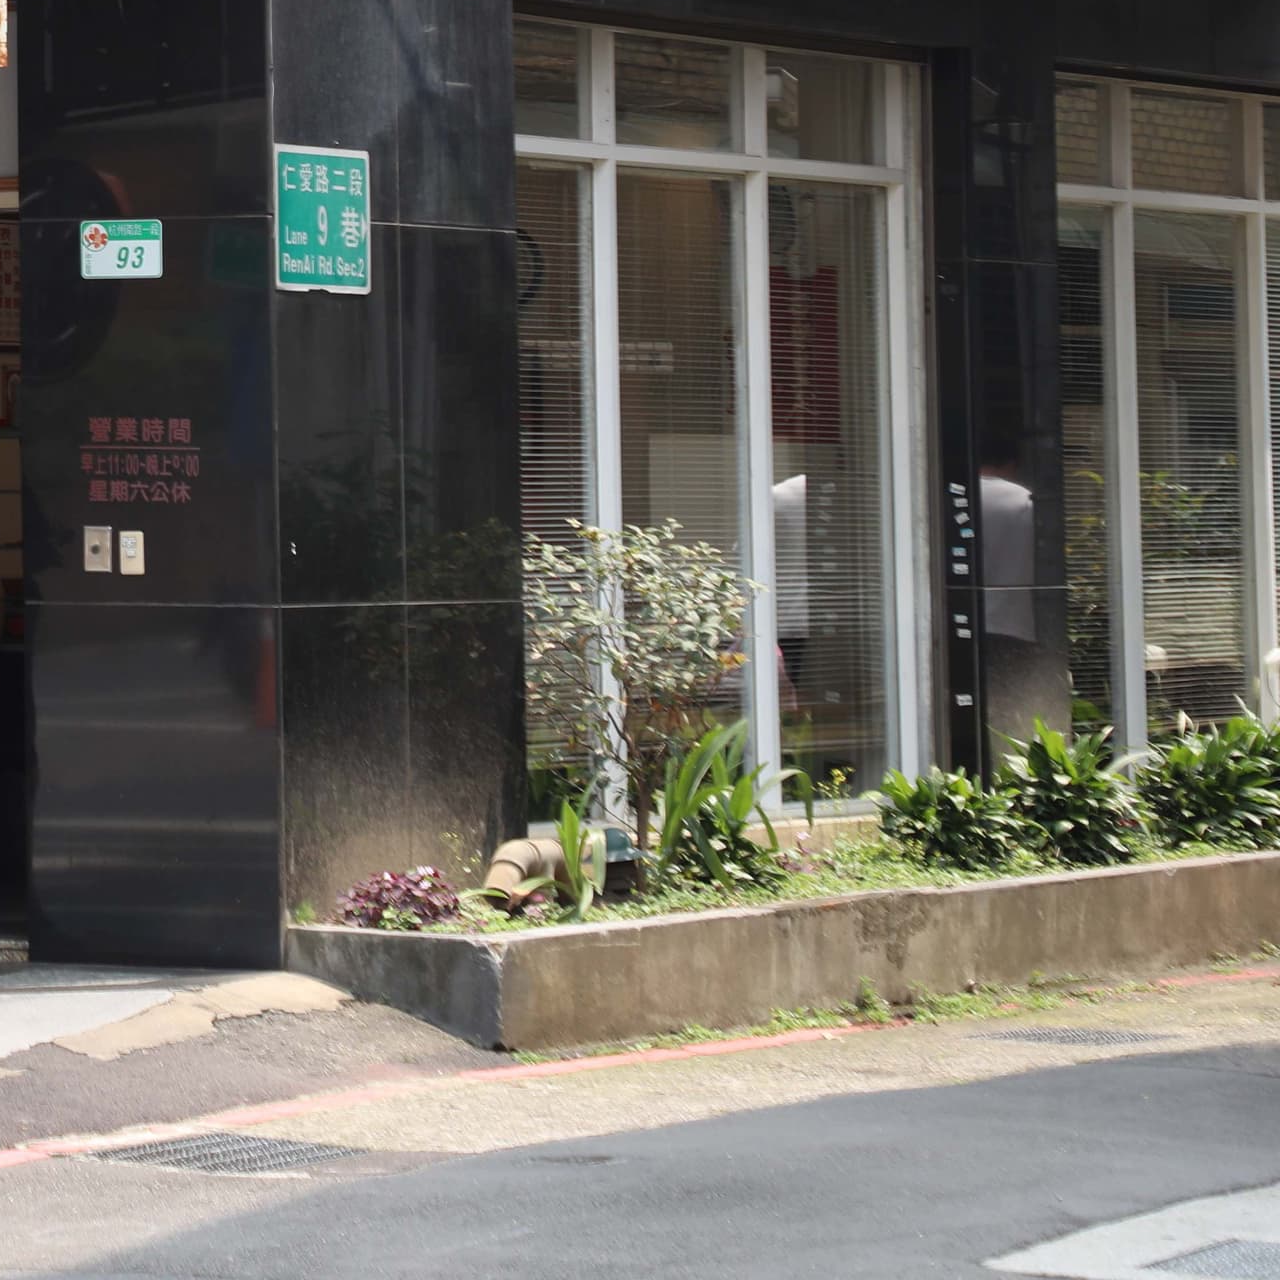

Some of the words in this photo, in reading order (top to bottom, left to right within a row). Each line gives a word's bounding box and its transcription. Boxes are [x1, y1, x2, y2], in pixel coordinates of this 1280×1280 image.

[282, 163, 363, 196] 仁愛路二段
[285, 225, 308, 246] Lane
[116, 246, 145, 269] 93
[283, 253, 315, 275] RenAi
[88, 416, 192, 444] 營業時間
[88, 479, 192, 504] 星期六公休
